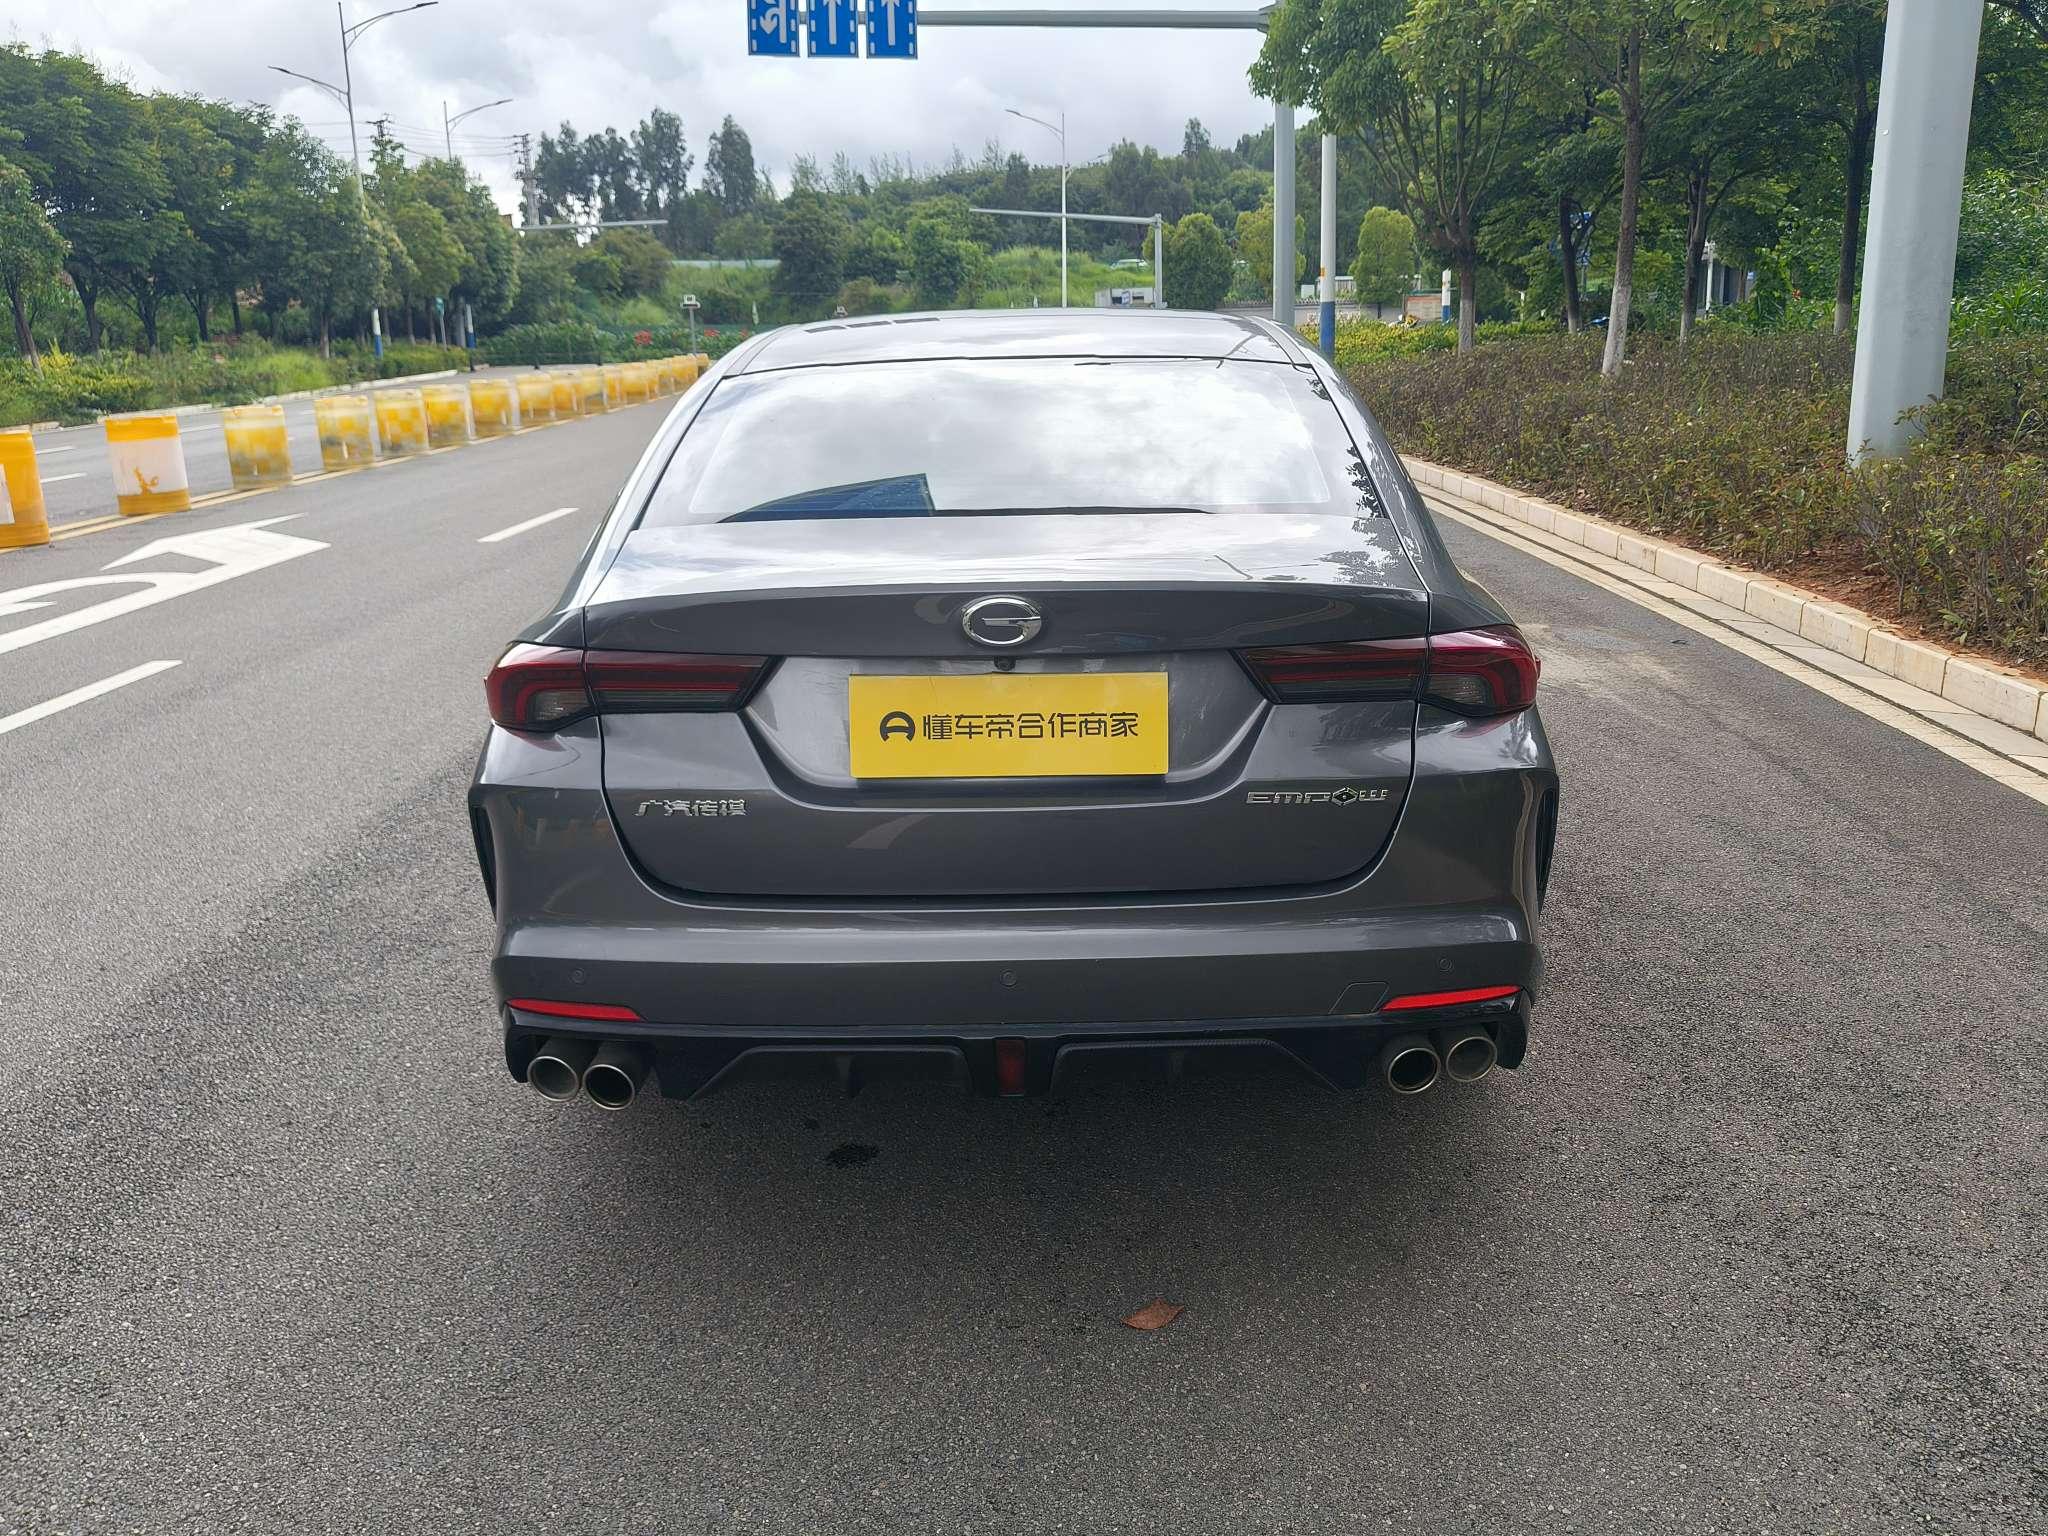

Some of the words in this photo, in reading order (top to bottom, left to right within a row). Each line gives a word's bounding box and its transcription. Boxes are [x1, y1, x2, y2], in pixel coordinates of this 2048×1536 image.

[923, 712, 1139, 740] 懂车帝合作商家
